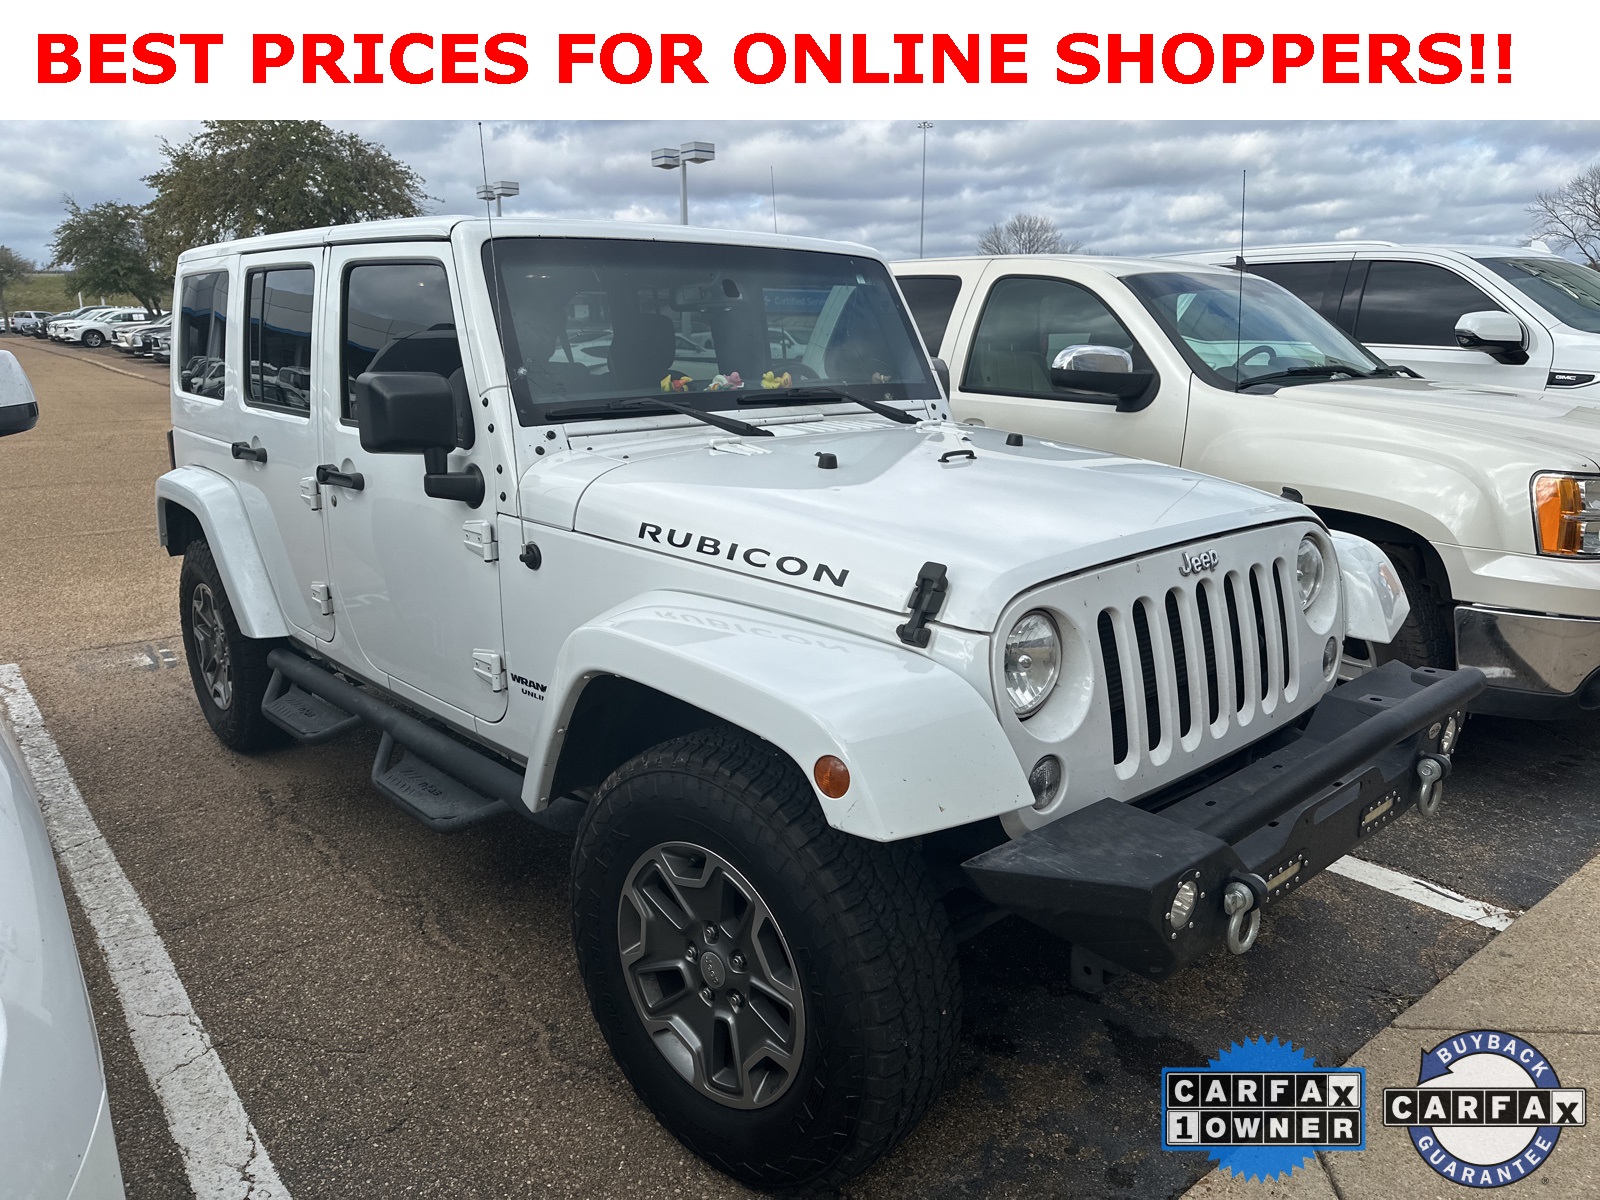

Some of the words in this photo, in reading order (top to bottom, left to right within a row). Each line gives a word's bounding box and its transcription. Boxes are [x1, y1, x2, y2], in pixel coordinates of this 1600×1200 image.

[638, 522, 850, 588] RUBICON
[1179, 549, 1219, 577] Jeep
[510, 672, 548, 693] WRAN
